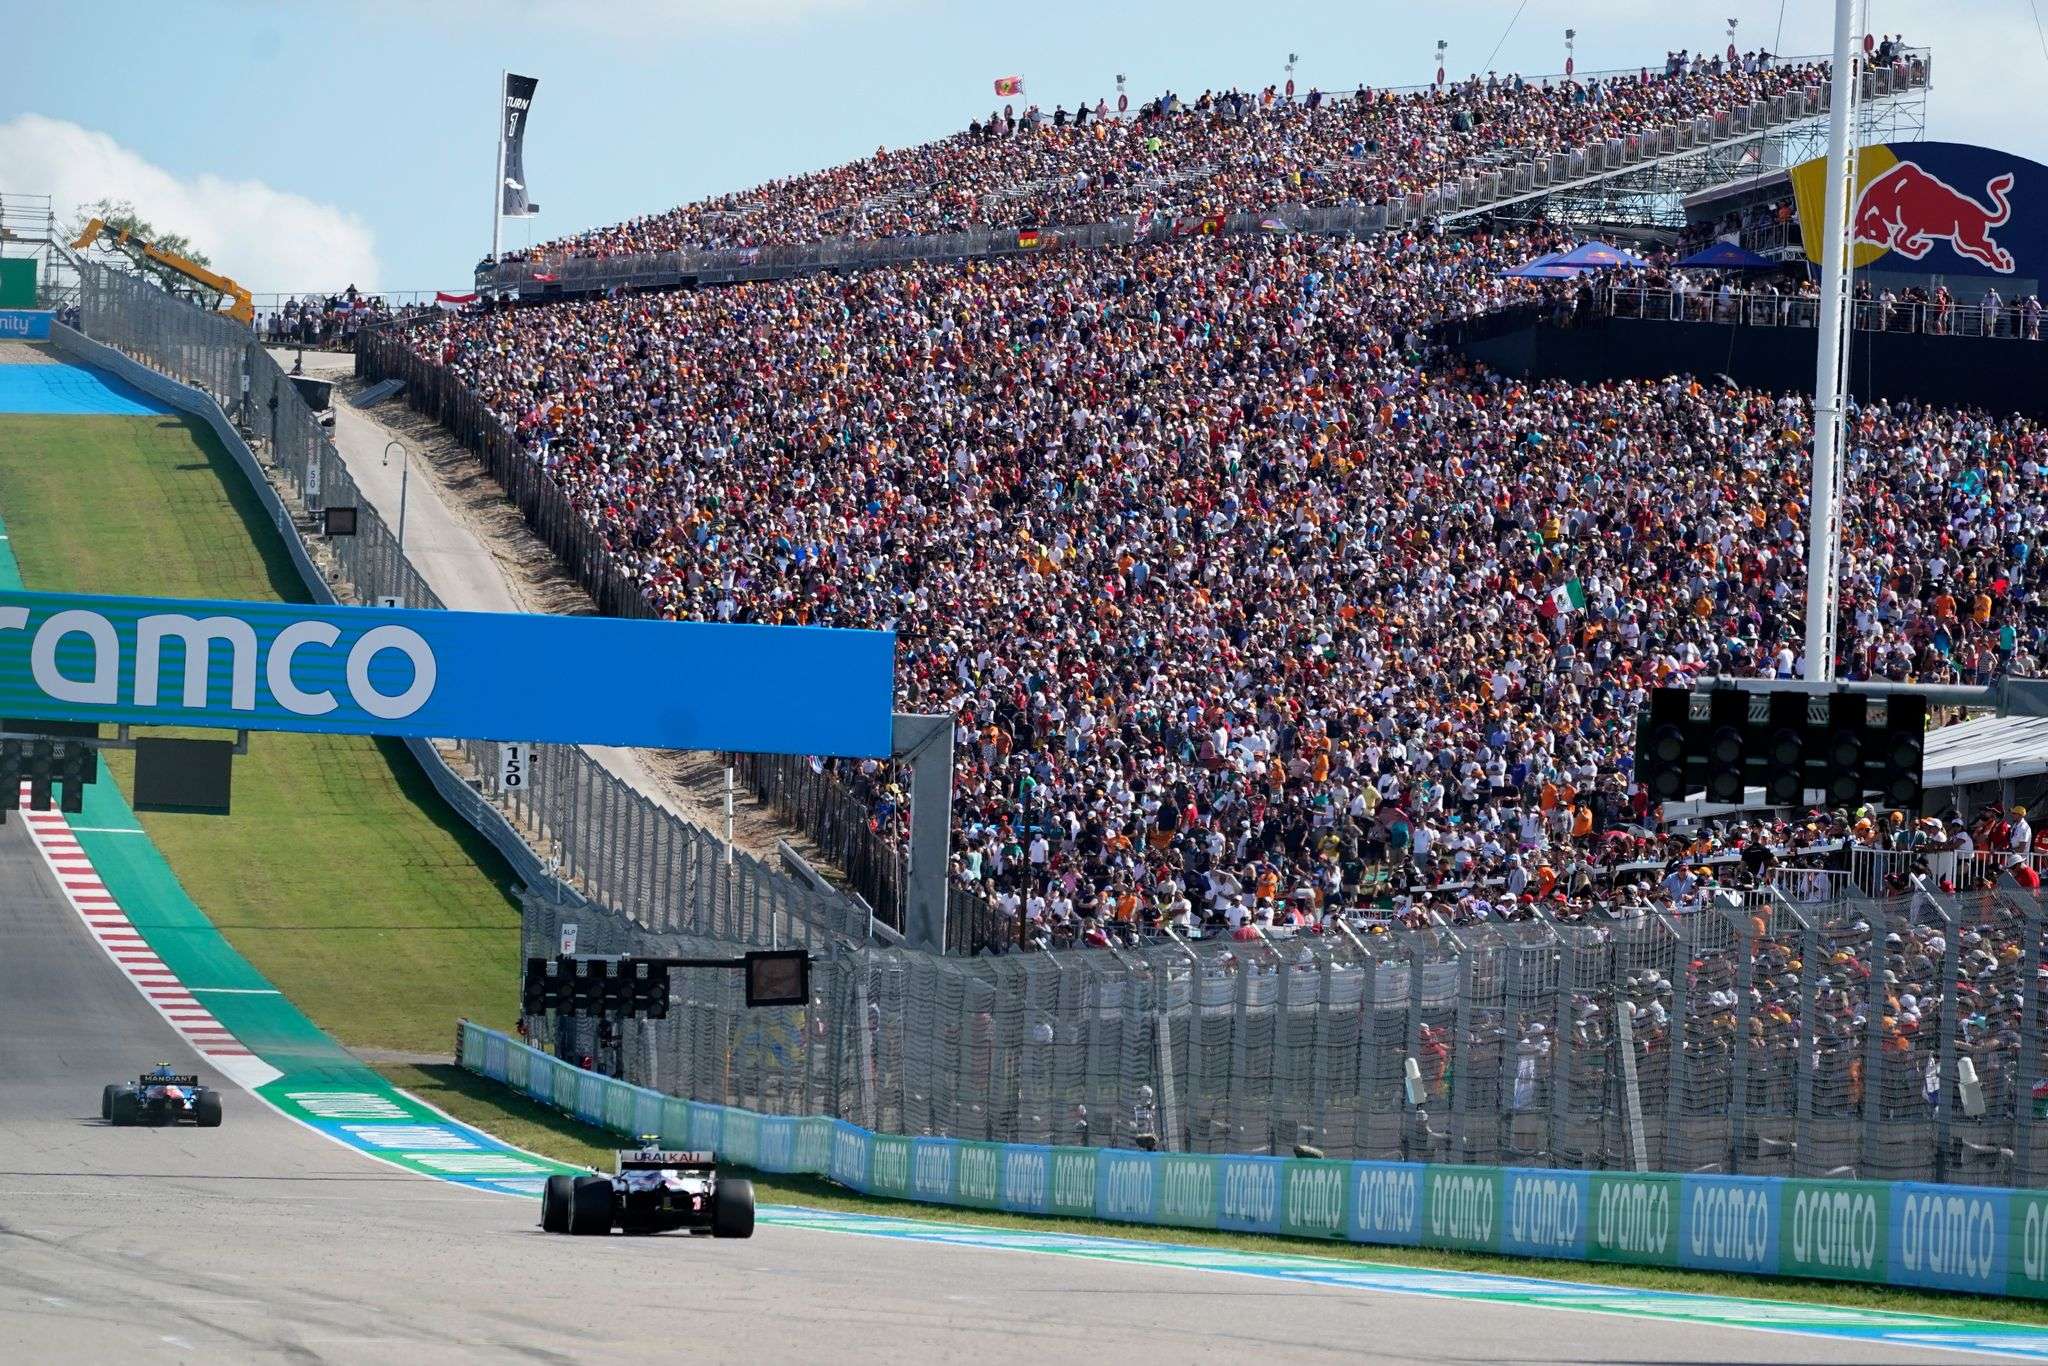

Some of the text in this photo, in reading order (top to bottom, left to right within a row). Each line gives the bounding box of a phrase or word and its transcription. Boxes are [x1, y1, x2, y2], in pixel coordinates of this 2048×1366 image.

[506, 96, 529, 110] TURN
[506, 746, 521, 787] 150
[634, 1151, 701, 1162] URALKALI
[1107, 1160, 1151, 1214] aramco
[1164, 1162, 1212, 1217] aramco
[1225, 1164, 1275, 1222] aramco
[1289, 1168, 1342, 1229] aramco
[1358, 1170, 1414, 1232] aramco
[1432, 1174, 1493, 1242] aramco
[1512, 1177, 1578, 1247] aramco
[1598, 1182, 1669, 1254] aramco
[1692, 1186, 1767, 1262] aramco
[1793, 1190, 1876, 1269] aramco
[1903, 1194, 1994, 1280] aramco
